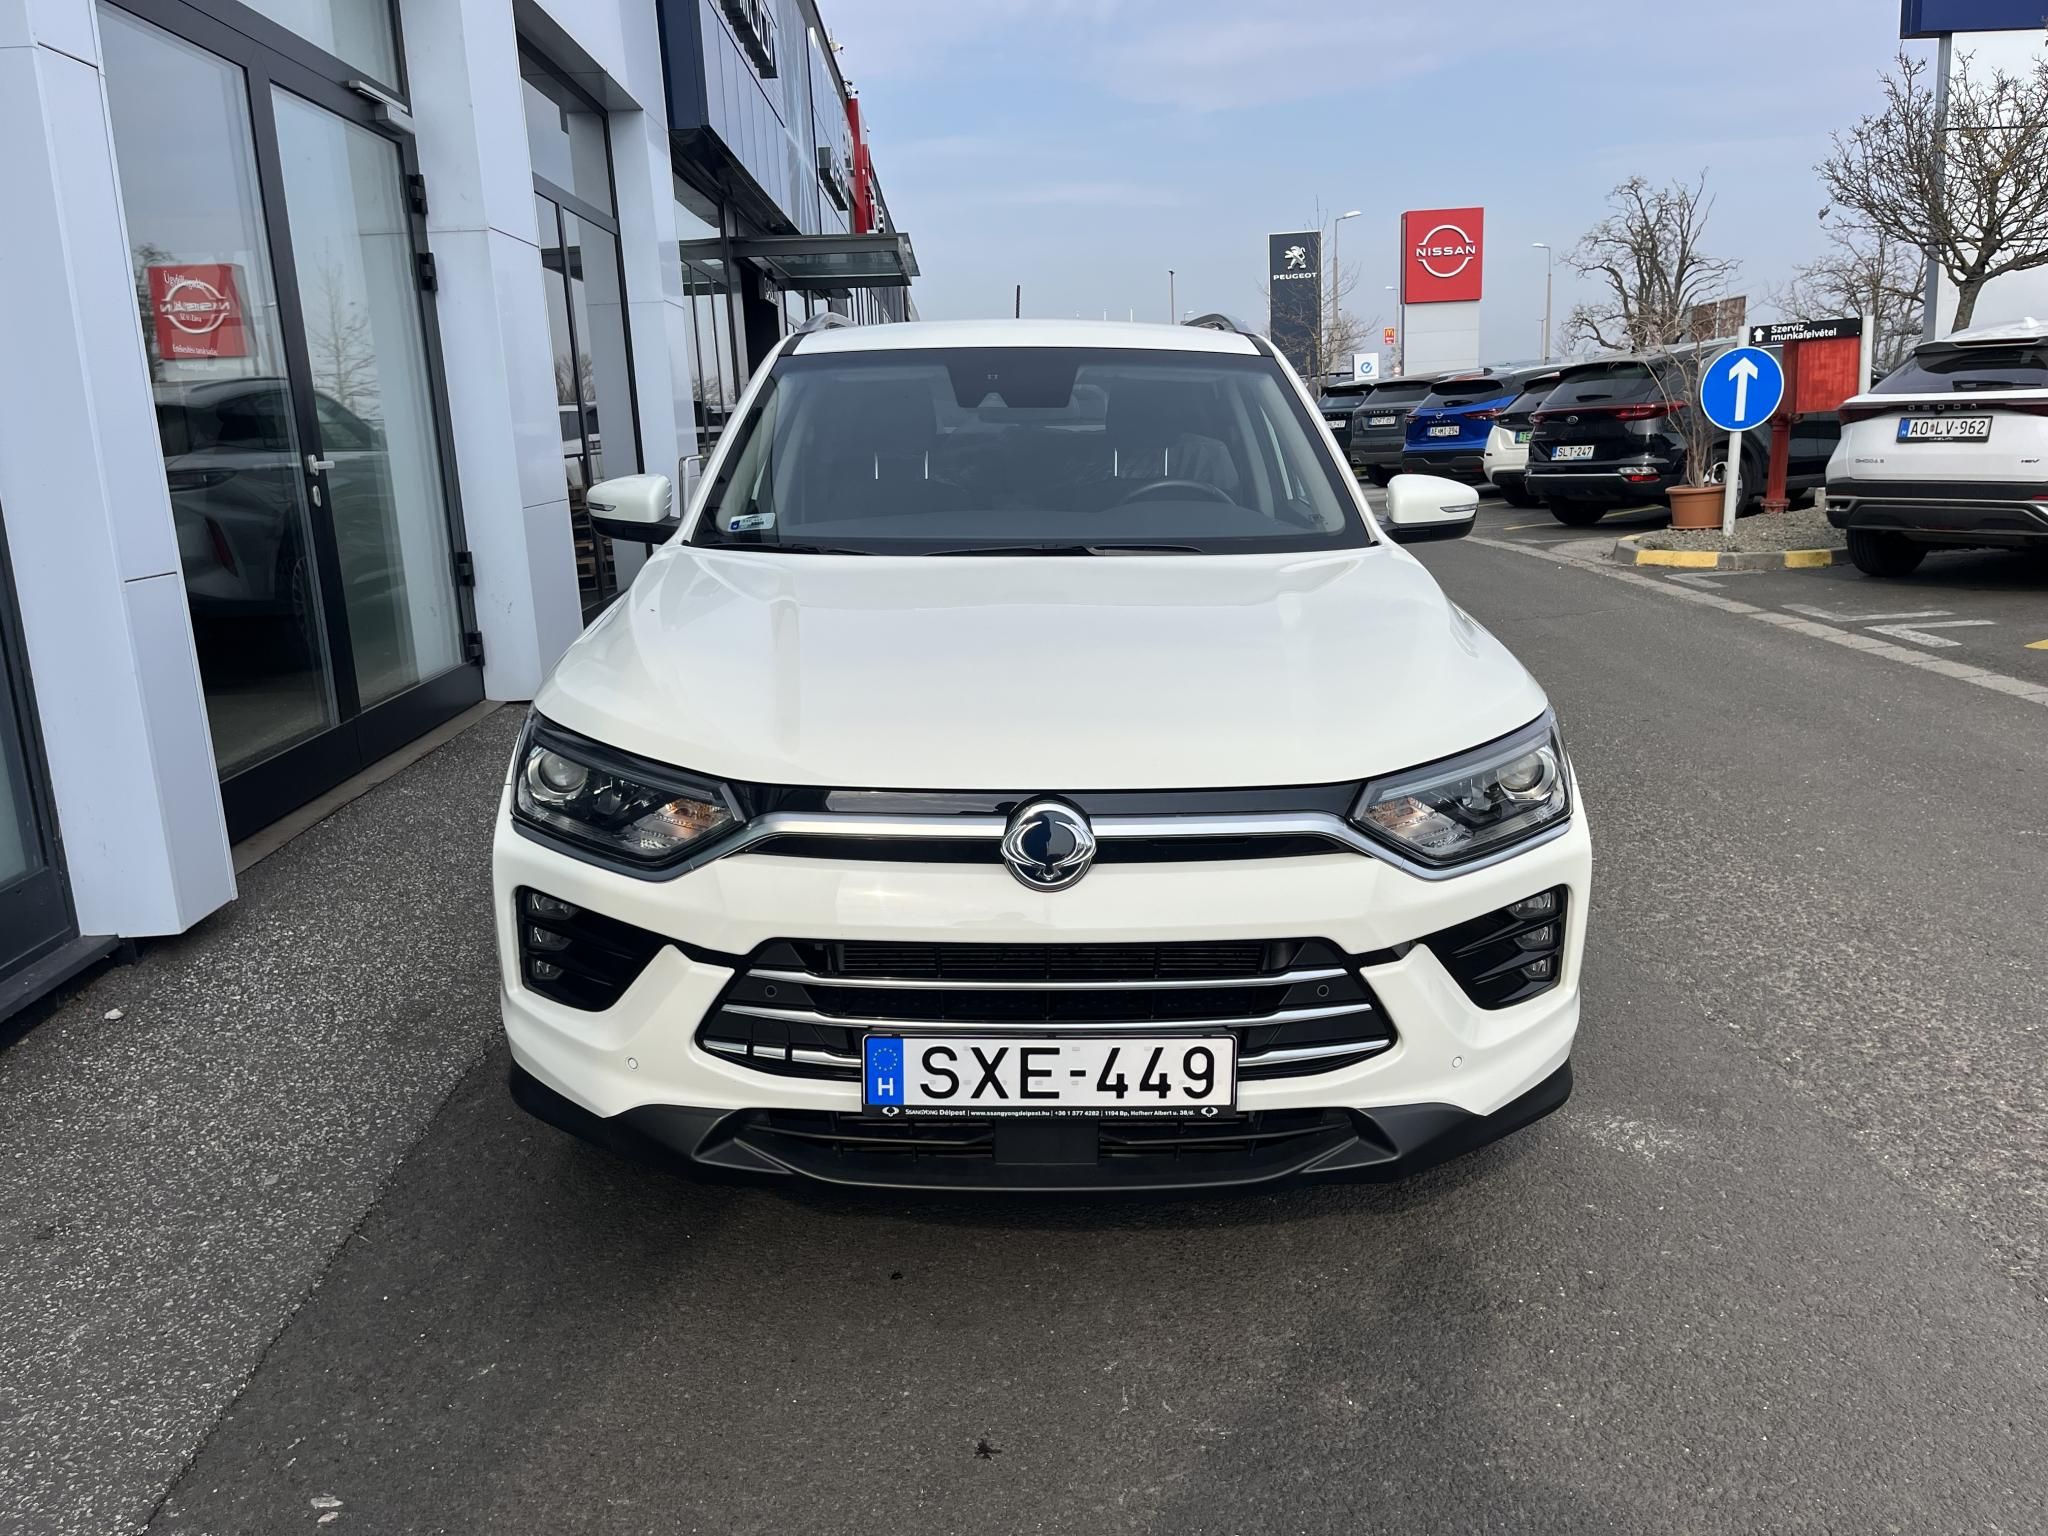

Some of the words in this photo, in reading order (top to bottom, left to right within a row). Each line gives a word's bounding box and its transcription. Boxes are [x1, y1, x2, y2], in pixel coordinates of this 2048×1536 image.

[1416, 245, 1476, 257] NISSAN
[1273, 271, 1318, 281] PEUGEOT
[1771, 323, 1804, 333] Szerviz
[1771, 328, 1837, 341] munkafelvétel
[1558, 446, 1592, 457] SLT-247
[877, 1077, 894, 1096] H
[920, 1046, 1215, 1099] SXE-449
